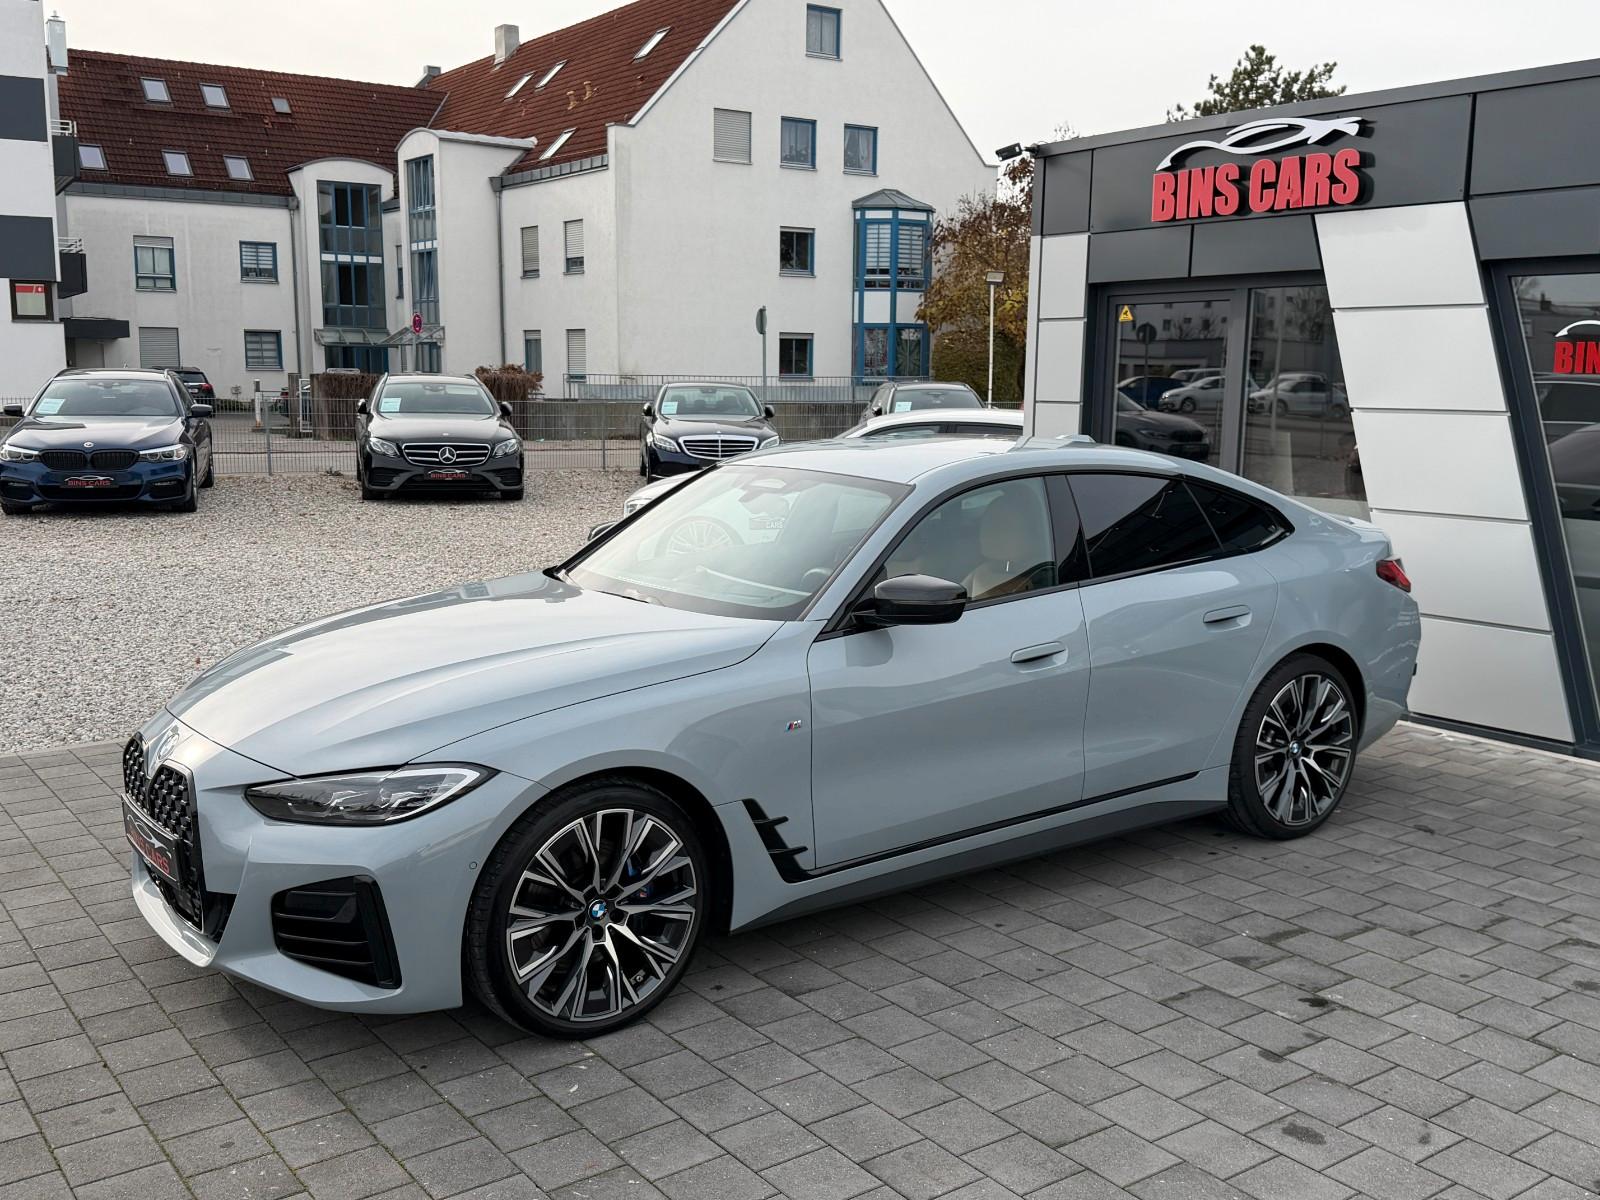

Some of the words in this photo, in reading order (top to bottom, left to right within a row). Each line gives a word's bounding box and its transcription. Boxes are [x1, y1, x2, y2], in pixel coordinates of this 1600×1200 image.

[1152, 163, 1240, 222] BINS
[1249, 148, 1361, 213] CARS
[145, 843, 170, 873] CARS
